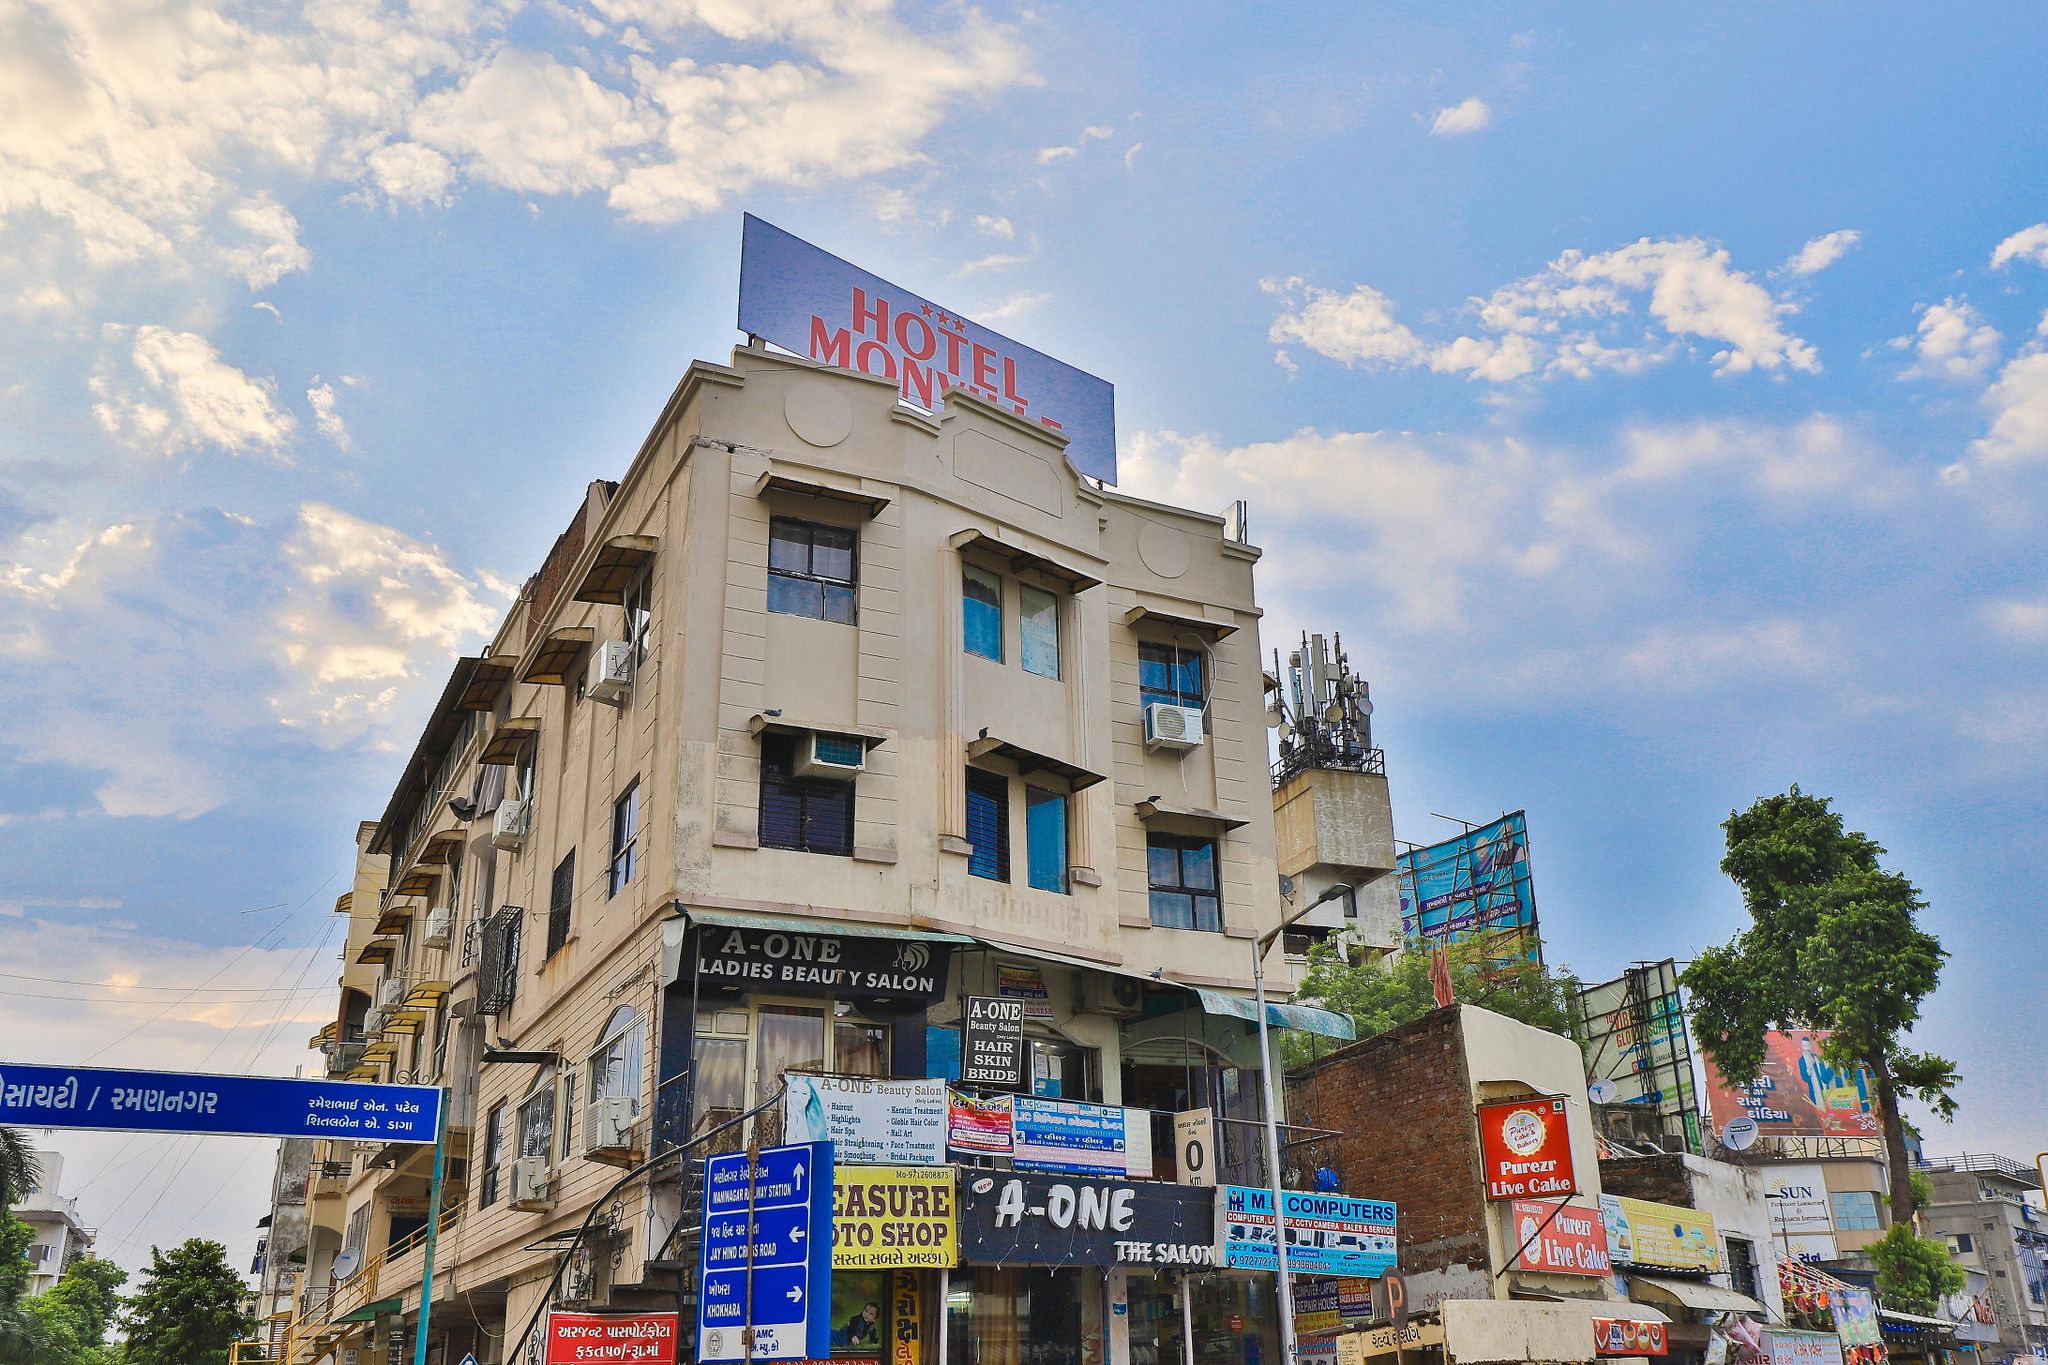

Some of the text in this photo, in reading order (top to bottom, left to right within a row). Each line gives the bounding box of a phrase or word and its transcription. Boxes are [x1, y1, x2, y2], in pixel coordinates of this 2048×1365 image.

[852, 286, 1029, 407] HOTEL
[720, 930, 842, 963] A-ONE
[699, 958, 934, 992] LADIES BEAUTY SALON
[970, 1001, 1021, 1021] A-ONE
[970, 1020, 1020, 1033] Beauty Salon
[974, 1040, 1014, 1053] HAIR
[974, 1055, 1012, 1067] SKIN
[967, 1068, 1017, 1081] BRIDE
[821, 1079, 942, 1098] A-ONE Beauty Salon
[111, 1088, 218, 1114] રમણનગર
[308, 1096, 420, 1113] રમેશભાઈ એન. પટેલ
[831, 1102, 854, 1112] Haircut
[891, 1106, 943, 1116] Keratin Treatment
[306, 1113, 413, 1130] શિતલબેન એ. ડાગા
[831, 1114, 861, 1125] Highlights
[910, 1117, 923, 1126] Hair
[924, 1118, 939, 1127] Color
[830, 1126, 855, 1137] Hair Spa
[891, 1129, 913, 1138] Nail Art
[1514, 1131, 1531, 1142] Cake
[844, 1138, 884, 1150] Straightening
[890, 1141, 935, 1150] Face Treatment
[1516, 1138, 1539, 1149] Bakery
[834, 1150, 876, 1161] air Smoothing
[890, 1152, 935, 1163] Bridal Packages
[1185, 1139, 1203, 1171] 0
[1500, 1159, 1556, 1176] Purezr
[977, 1181, 992, 1193] New
[1189, 1174, 1202, 1186] km
[1491, 1176, 1571, 1196] Live Cake
[769, 1183, 792, 1198] STATION
[1780, 1186, 1812, 1199] SUN
[833, 1184, 950, 1217] EASURE
[995, 1179, 1135, 1232] A-ONE
[1252, 1193, 1265, 1209] M
[1287, 1197, 1394, 1221] COMPUTERS
[1227, 1212, 1267, 1225] COMPUTER,
[1296, 1218, 1313, 1228] CCTV
[1314, 1220, 1340, 1231] CAMERA
[1343, 1223, 1362, 1233] SALES
[1363, 1225, 1368, 1233] &
[1369, 1226, 1395, 1235] SERVICE
[1555, 1212, 1592, 1237] Purezr
[881, 1222, 948, 1247] SHOP
[710, 1247, 721, 1261] JAY
[723, 1245, 737, 1260] HIND
[760, 1242, 777, 1257] ROAD
[1113, 1240, 1216, 1265] THE SALON
[1229, 1244, 1248, 1252] acer
[1294, 1250, 1318, 1258] Lenovo
[1544, 1239, 1609, 1272] Live Cake
[1297, 1296, 1339, 1312] REPAIR HOUSE
[1387, 1277, 1403, 1318] P
[707, 1303, 741, 1318] KHOKHARA
[756, 1329, 774, 1338] AMC
